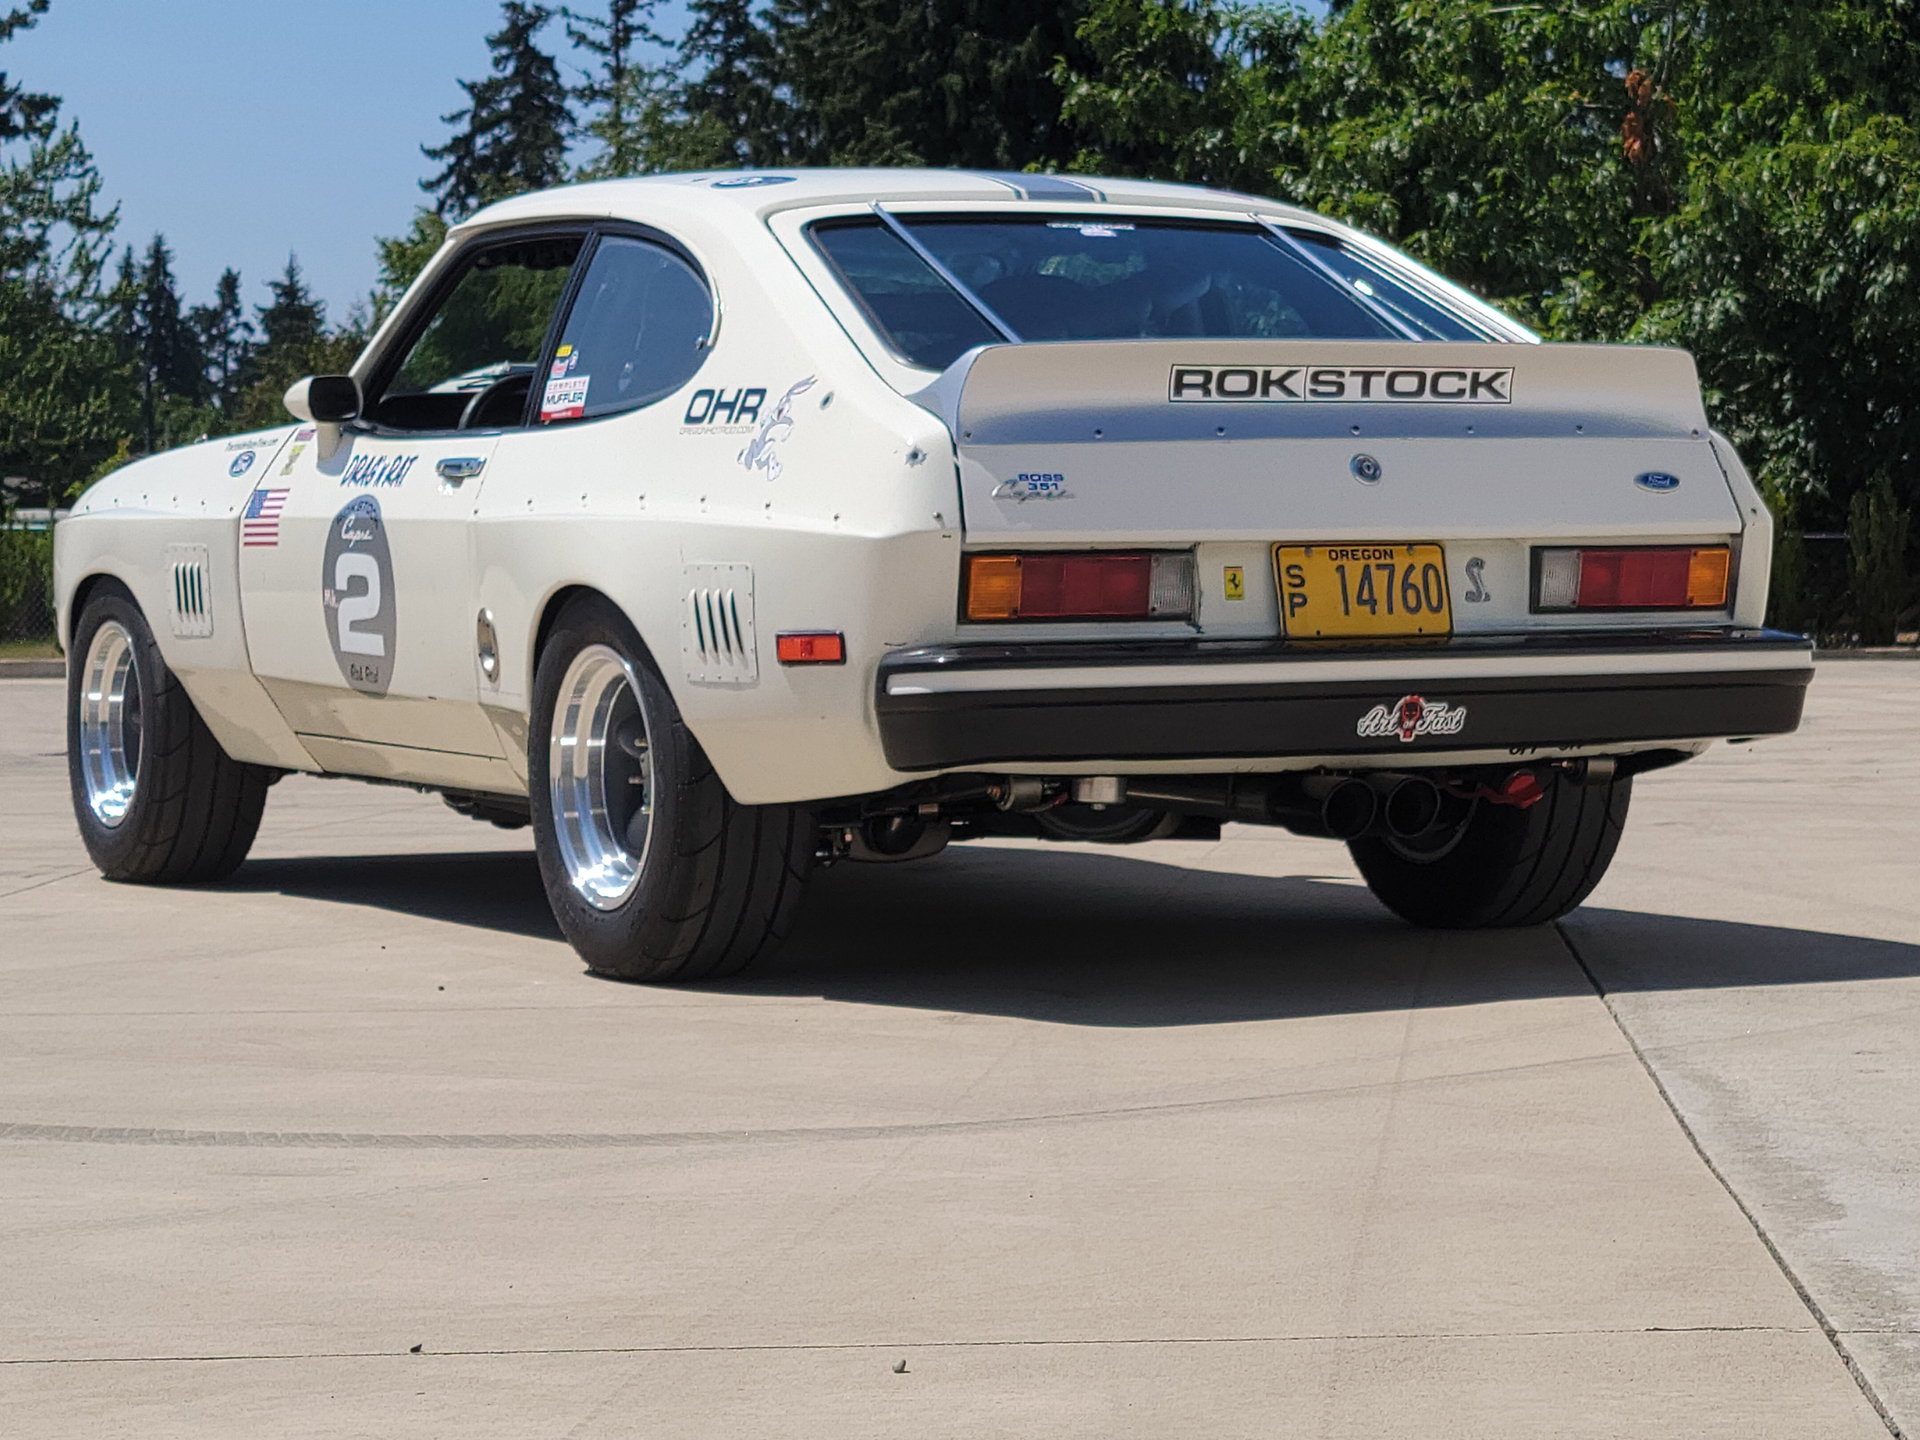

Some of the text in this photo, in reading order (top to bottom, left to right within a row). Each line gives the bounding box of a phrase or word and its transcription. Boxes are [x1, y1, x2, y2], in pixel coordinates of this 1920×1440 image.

[546, 391, 584, 405] MUFFLER
[1172, 368, 1509, 400] ROKSTOCK
[683, 387, 768, 425] OHR
[1018, 473, 1064, 482] BOSS
[1027, 482, 1059, 491] 351
[1328, 549, 1394, 561] OREGON
[335, 552, 385, 656] 2
[1336, 563, 1444, 616] 14760
[1359, 707, 1400, 734] Art
[1416, 704, 1464, 732] Fast
